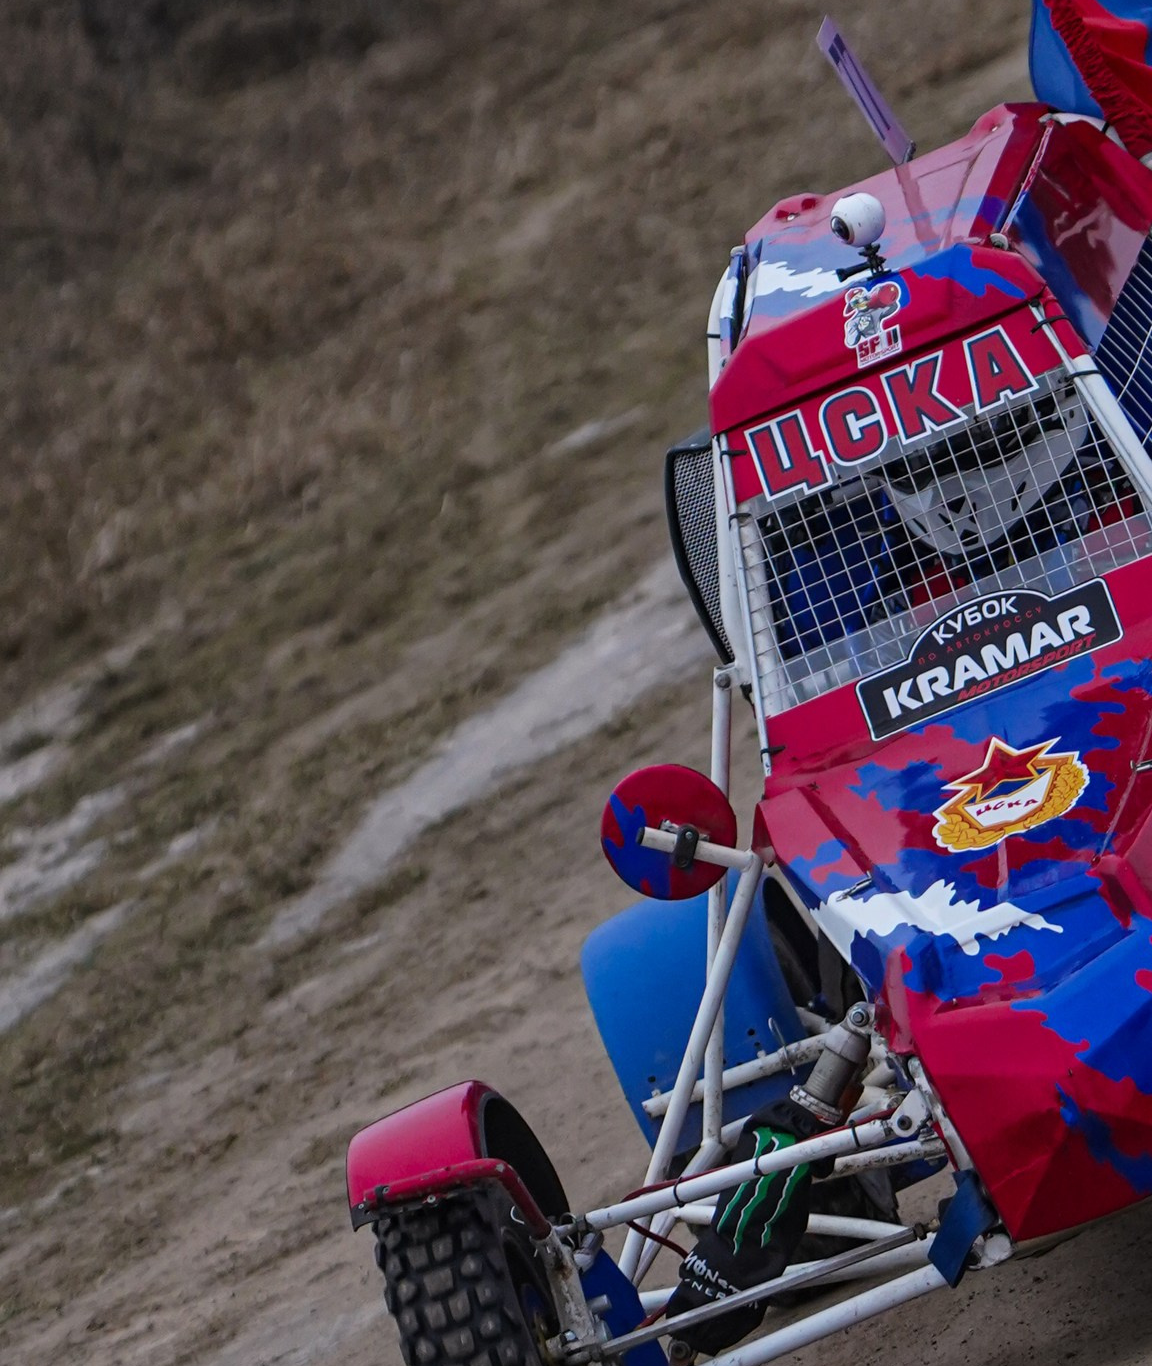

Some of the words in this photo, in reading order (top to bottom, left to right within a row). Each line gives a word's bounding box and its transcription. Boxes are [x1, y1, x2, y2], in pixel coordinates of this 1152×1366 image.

[745, 325, 1039, 501] ЦСКА
[931, 595, 1018, 645] КУБОК
[882, 604, 1096, 719] KRAMAR
[956, 633, 1097, 702] MOTORSPORT
[976, 797, 1039, 818] ЦСКА
